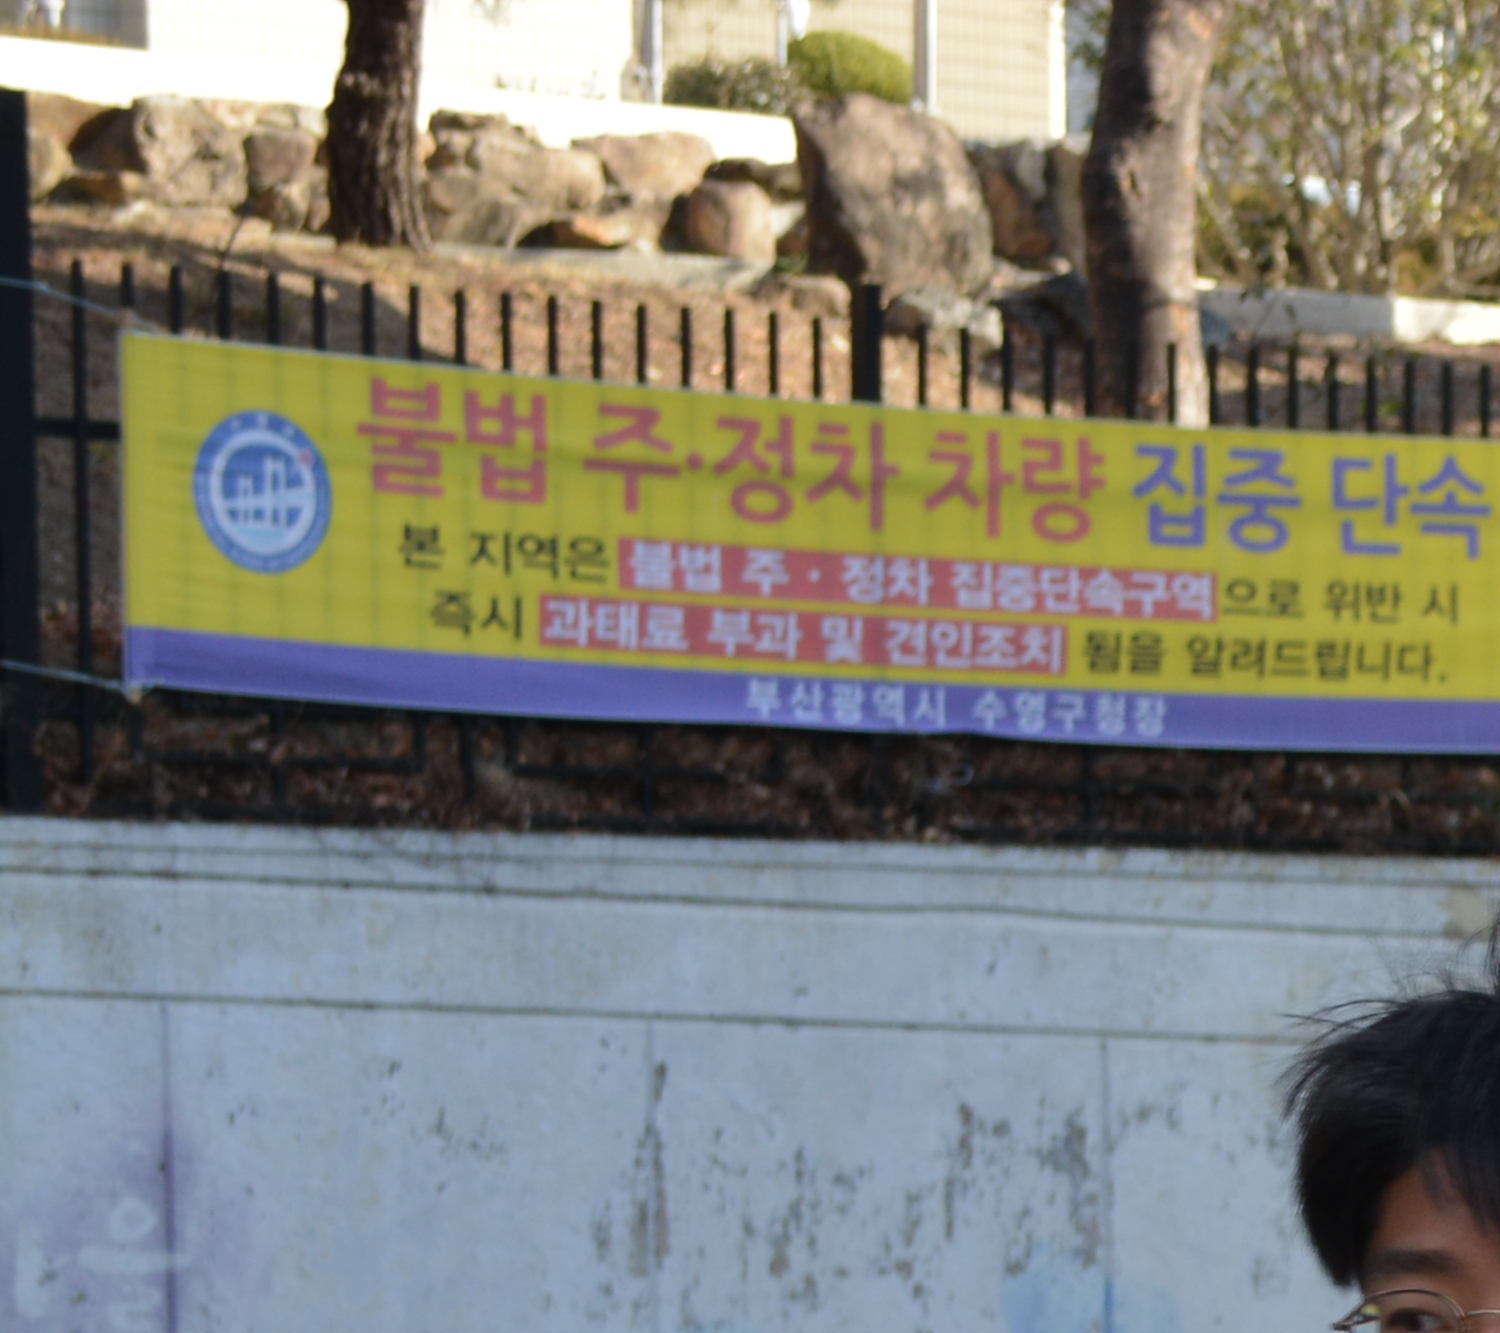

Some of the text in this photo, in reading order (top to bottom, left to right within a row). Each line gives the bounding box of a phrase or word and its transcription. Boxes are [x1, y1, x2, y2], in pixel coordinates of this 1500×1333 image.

[357, 376, 548, 504] 불법
[924, 430, 1106, 543] 차량
[1133, 444, 1302, 553] 집중
[1332, 453, 1492, 560] 단속
[400, 523, 443, 570] 본
[471, 531, 609, 583] 지역은
[629, 538, 722, 592] 불법
[1326, 578, 1403, 624] 위반
[1424, 584, 1459, 625] 시
[431, 590, 1448, 683] 즉시 과태료 부과 및 견인조치 됨을 알려드립니다.
[747, 677, 1167, 738] 부산광역시 수영구청장
